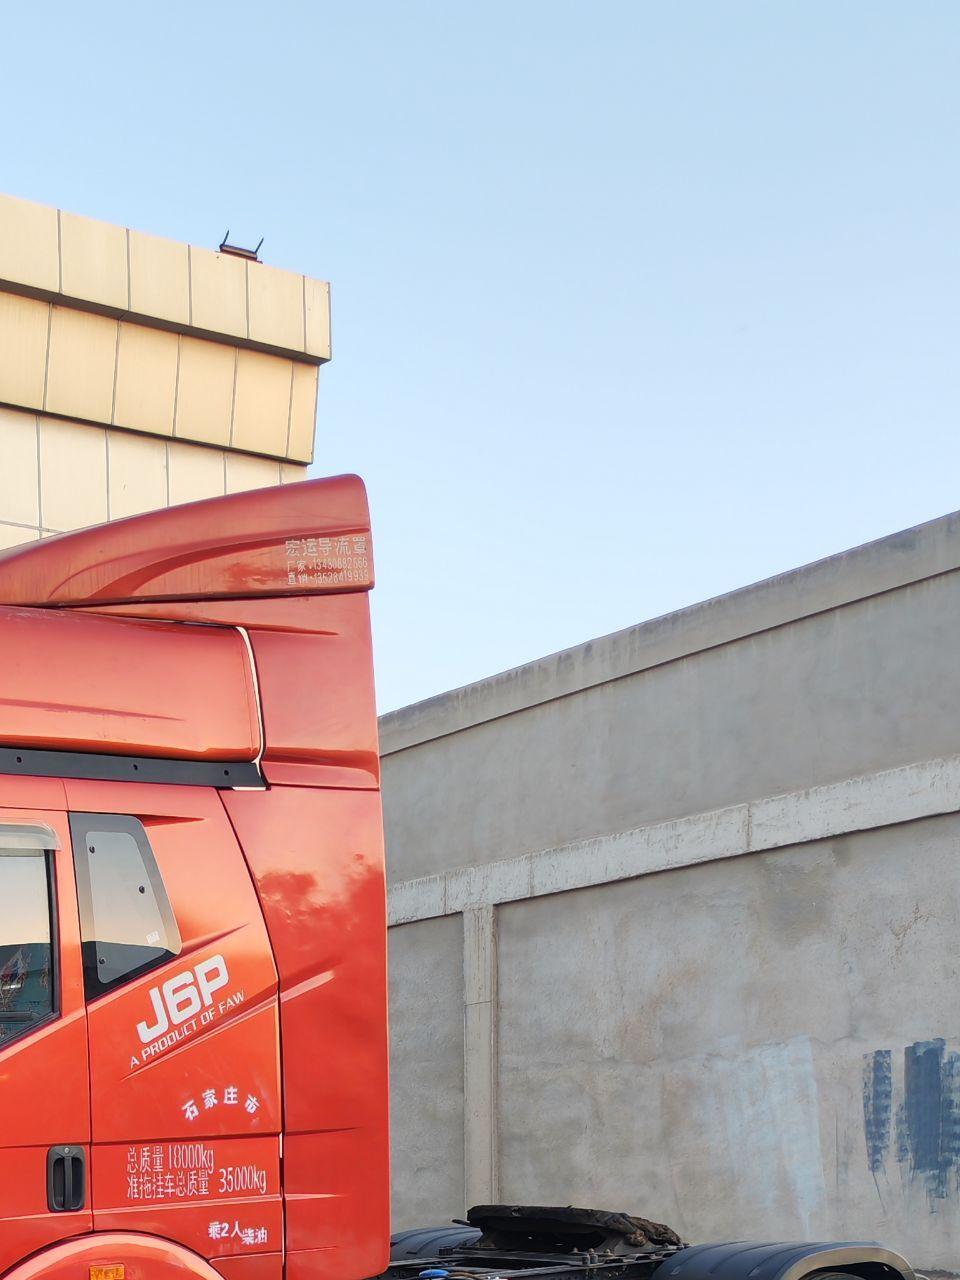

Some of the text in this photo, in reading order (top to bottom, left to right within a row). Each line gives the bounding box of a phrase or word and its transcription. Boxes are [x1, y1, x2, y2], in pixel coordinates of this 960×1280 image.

[136, 954, 230, 1044] J6P
[130, 989, 246, 1069] A PRODUCT OF FAW
[181, 1085, 260, 1120] 石家庄市
[218, 1165, 266, 1193] 35000kg
